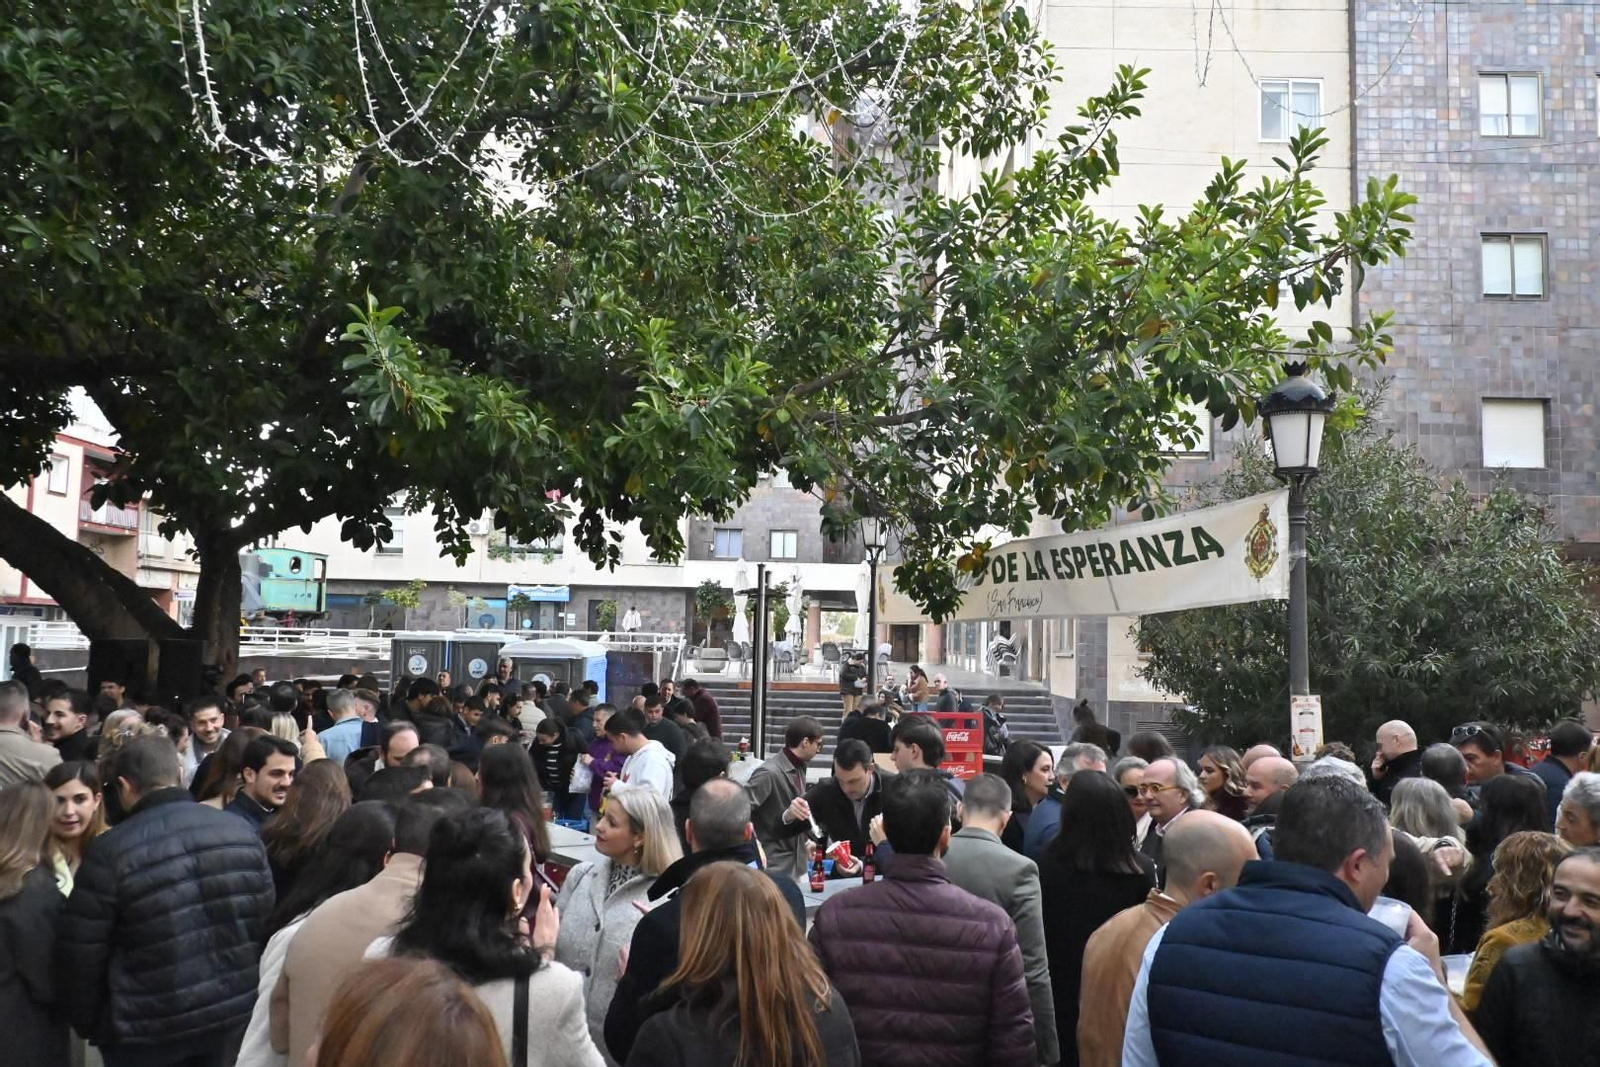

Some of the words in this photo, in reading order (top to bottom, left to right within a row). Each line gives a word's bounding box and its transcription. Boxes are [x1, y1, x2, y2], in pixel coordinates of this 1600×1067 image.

[991, 552, 1018, 584] DE
[1022, 550, 1050, 581] LA
[1050, 526, 1225, 580] ESPERANZA
